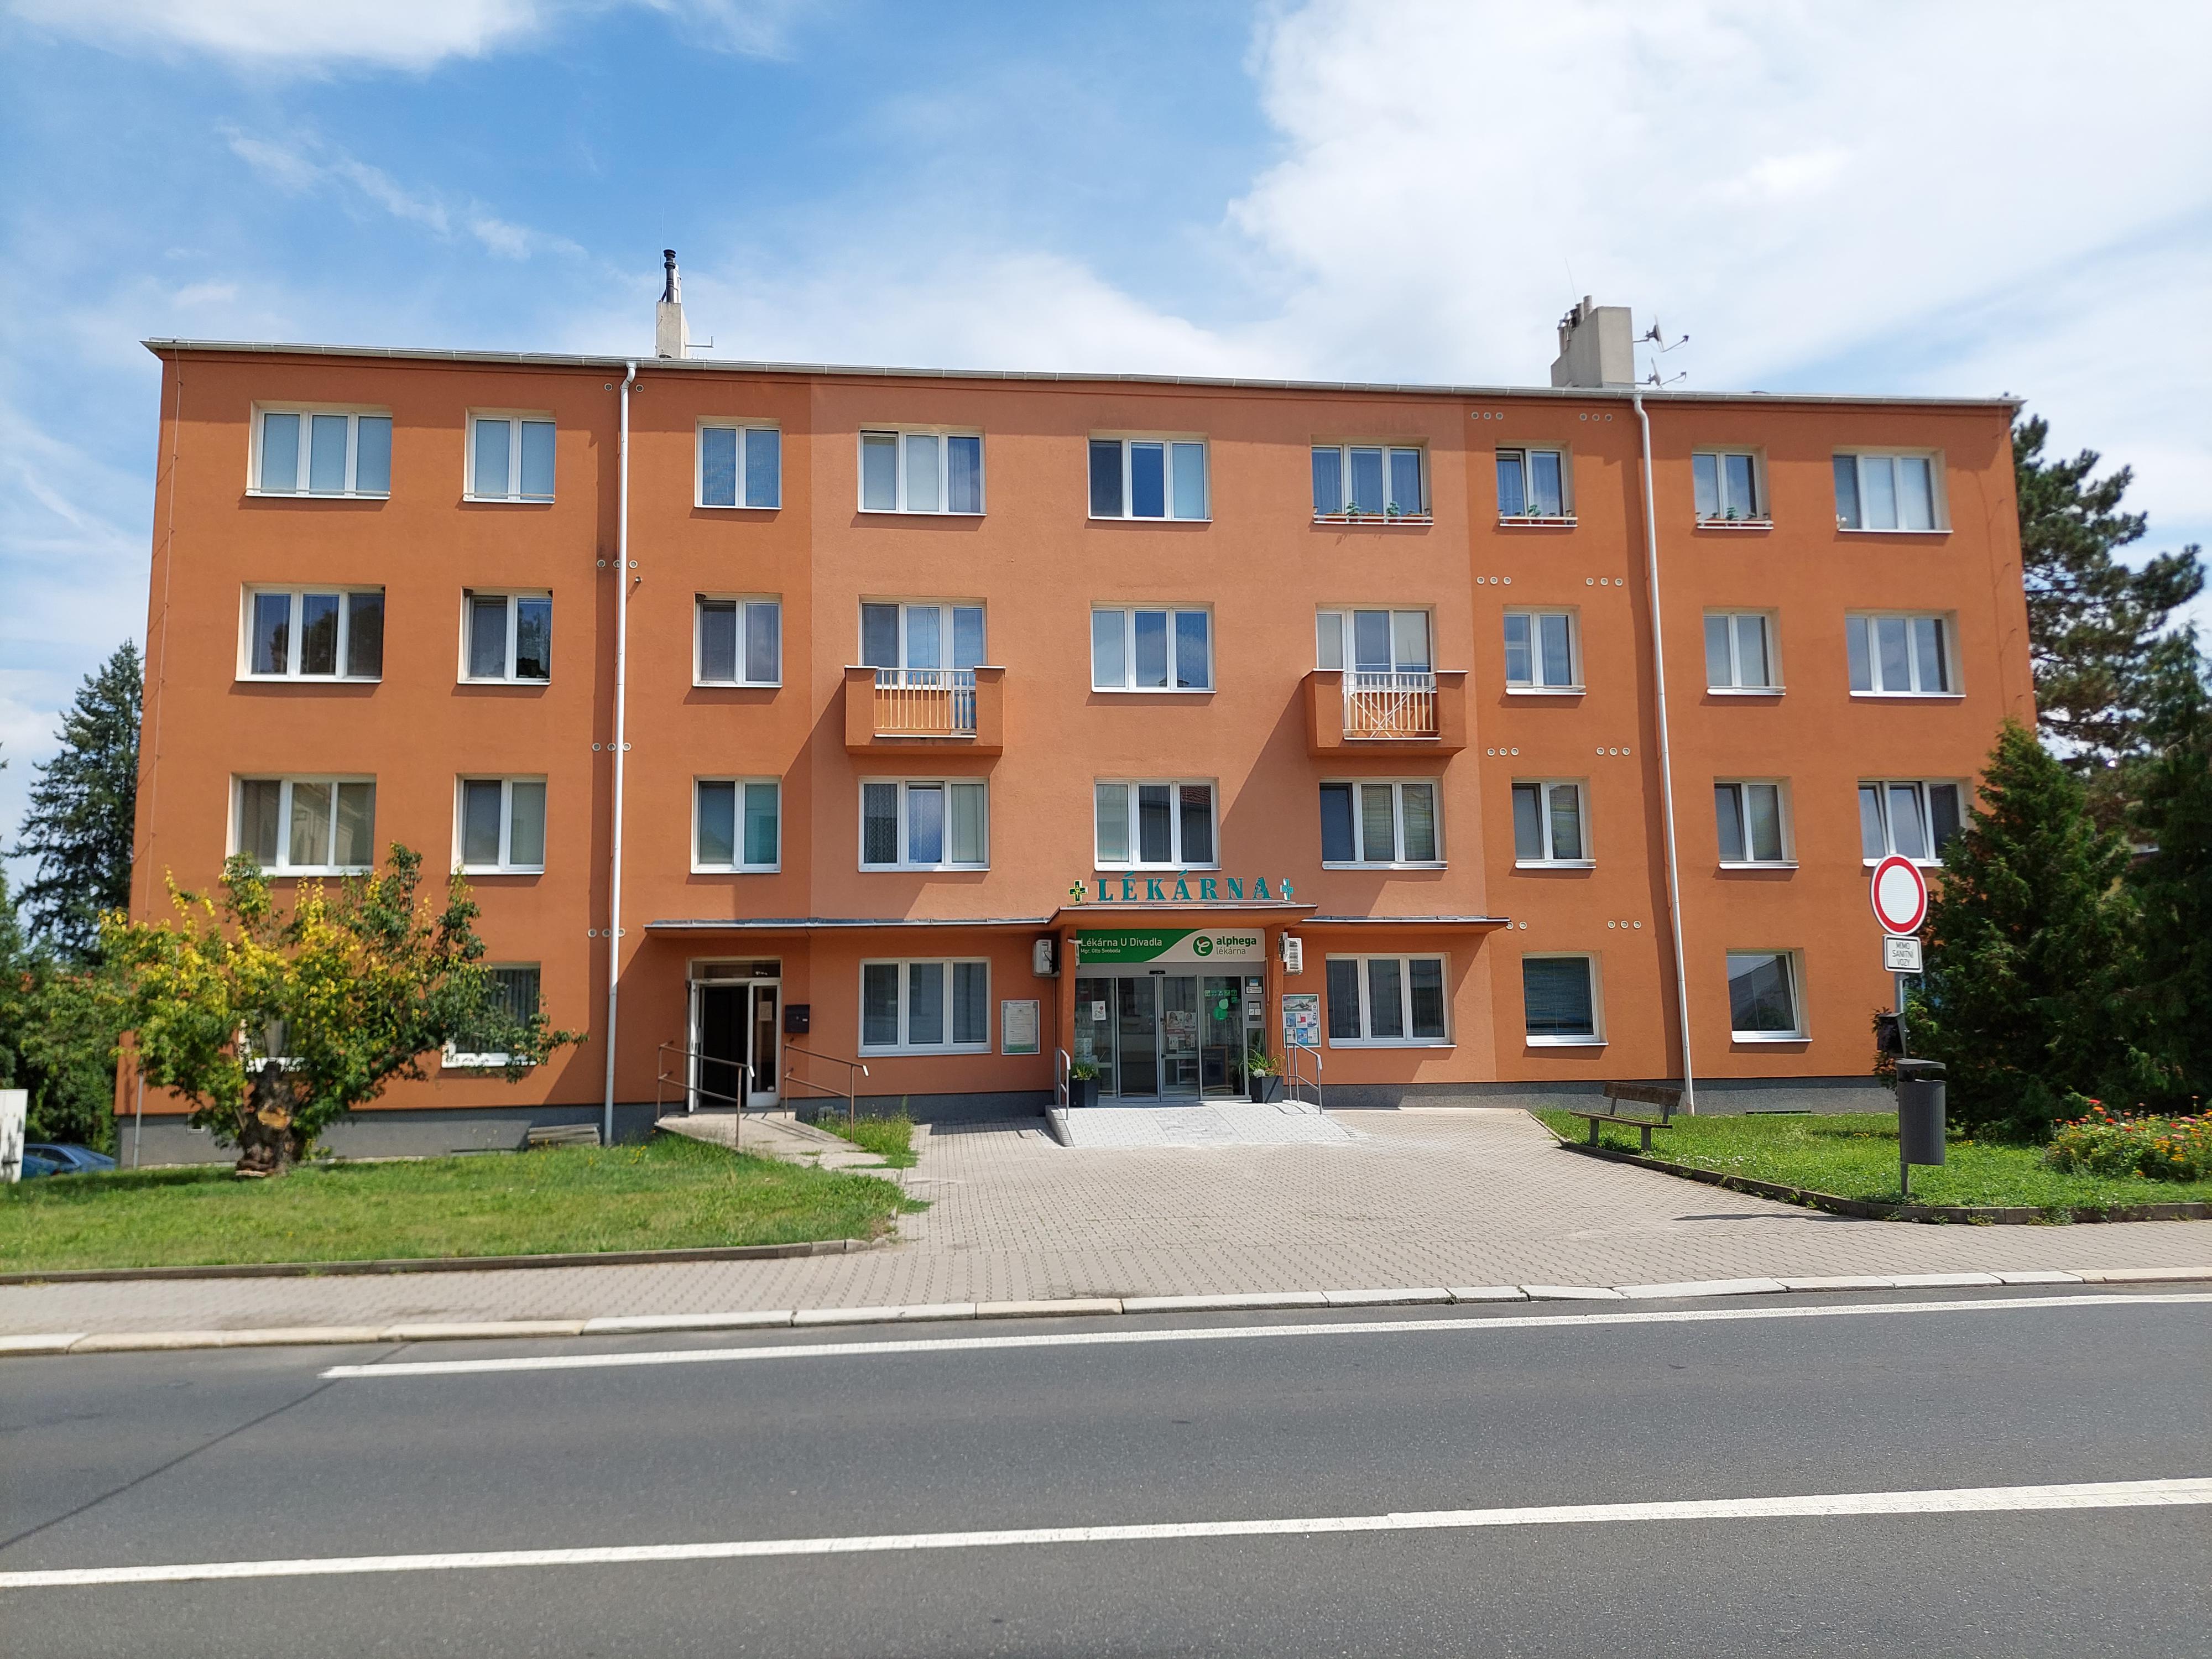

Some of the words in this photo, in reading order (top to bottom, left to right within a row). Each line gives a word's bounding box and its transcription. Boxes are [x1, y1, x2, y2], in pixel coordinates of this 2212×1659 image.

[1097, 869, 1272, 901] LÉKÁRNA
[1081, 938, 1118, 947] Lékárna
[1120, 938, 1127, 946] U
[1130, 937, 1162, 946] Divadla
[1216, 936, 1257, 947] alphega
[1896, 941, 1910, 950] MIMO
[1216, 947, 1246, 955] lékárna
